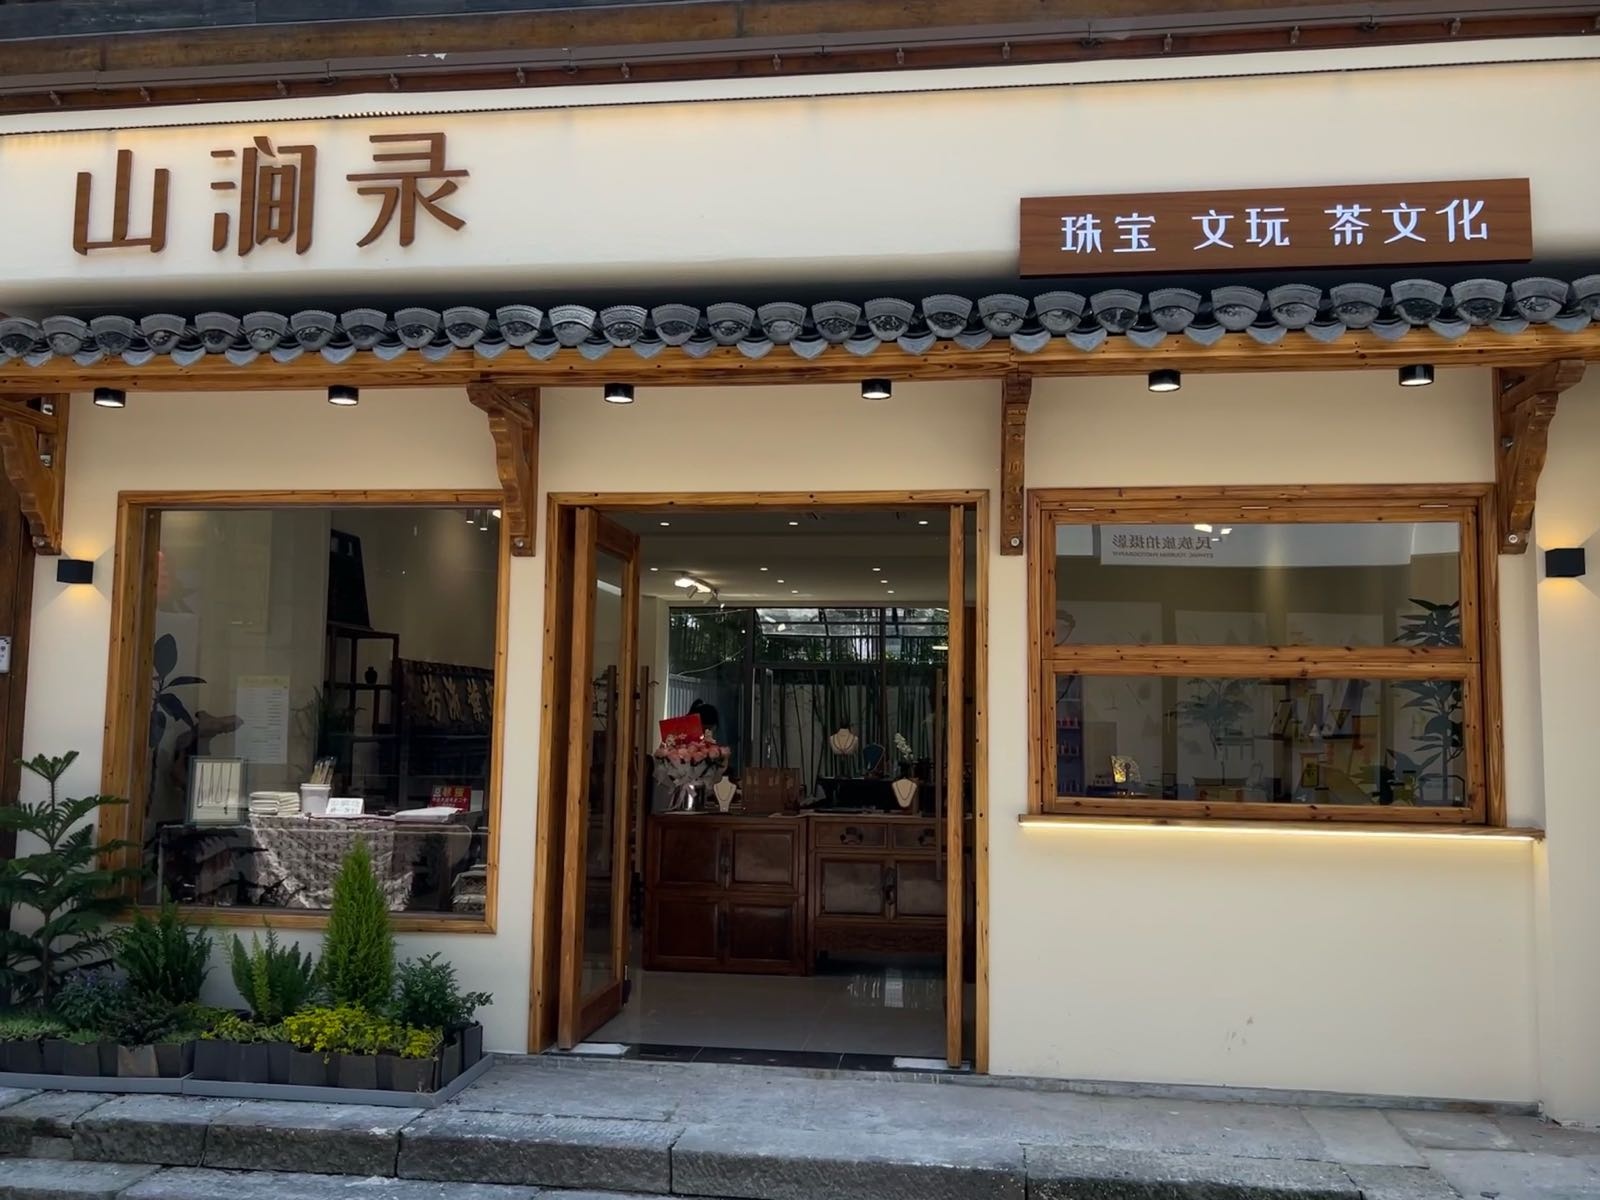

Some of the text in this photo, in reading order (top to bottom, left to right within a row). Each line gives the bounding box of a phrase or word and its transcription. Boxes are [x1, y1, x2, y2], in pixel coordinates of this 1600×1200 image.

[73, 132, 469, 257] 山涧录
[1061, 199, 1489, 254] 珠宝 文玩 茶文化
